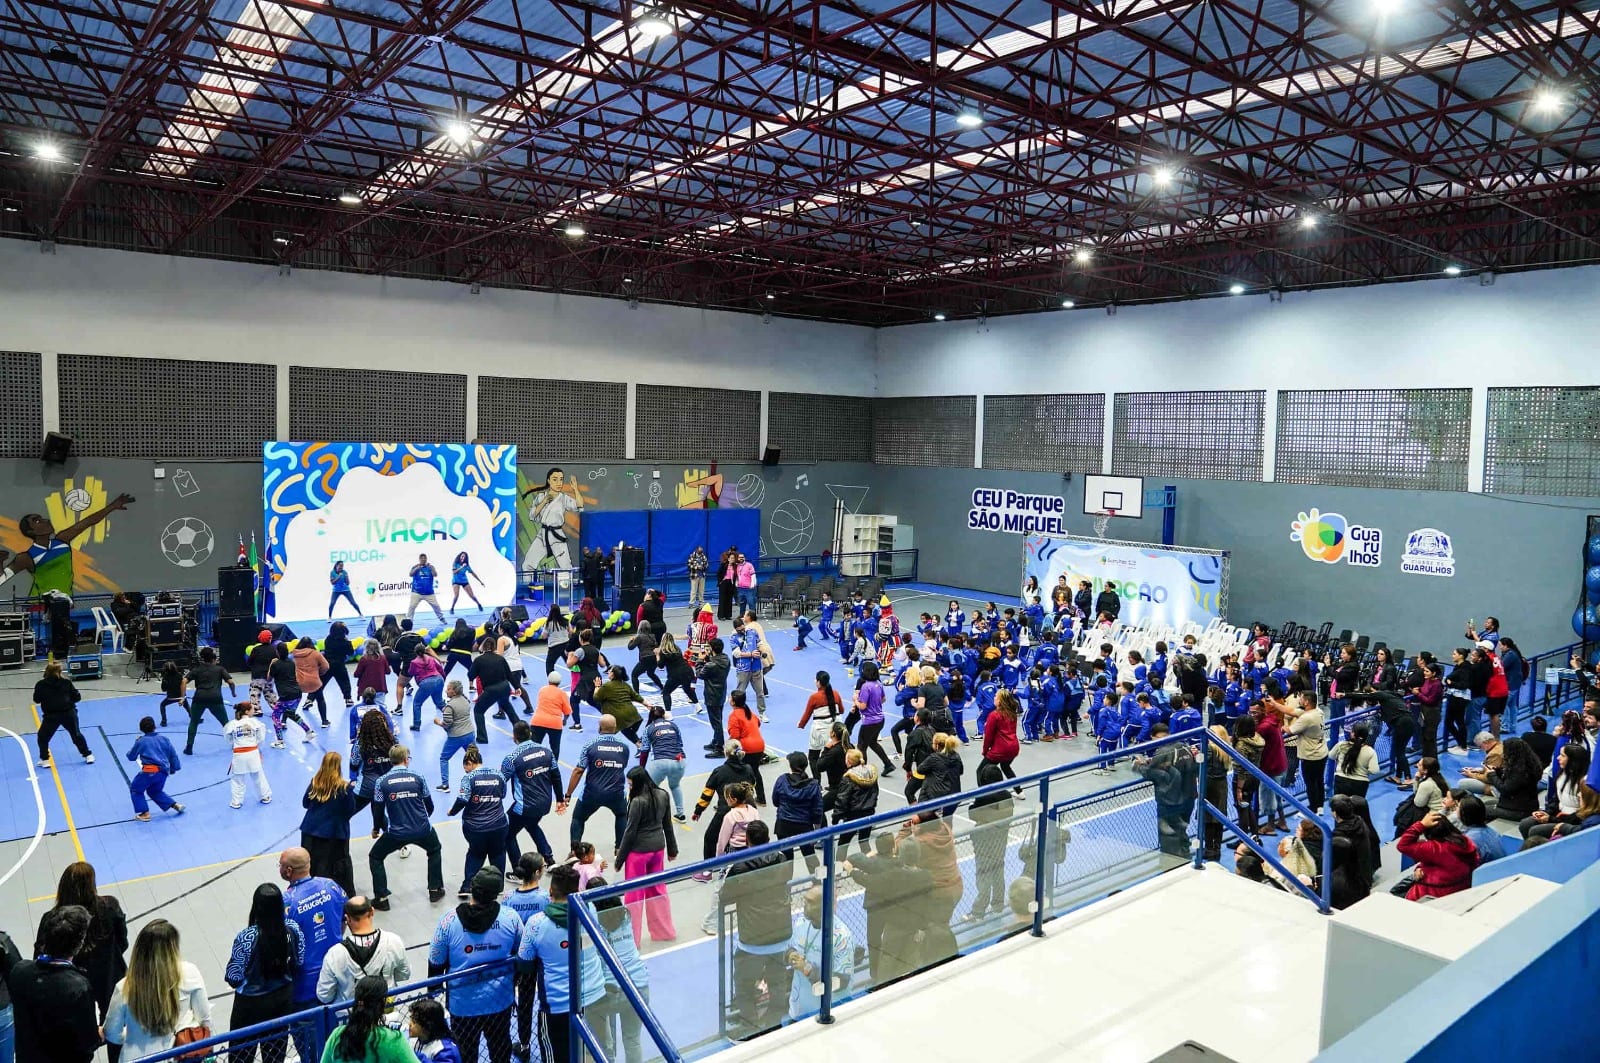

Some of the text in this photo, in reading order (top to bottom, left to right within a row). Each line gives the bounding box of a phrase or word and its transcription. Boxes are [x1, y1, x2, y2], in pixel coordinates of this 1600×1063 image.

[973, 489, 1063, 514] CEU Parque
[969, 508, 1066, 535] SÃO MIGUEL
[1351, 527, 1380, 542] Gua
[1364, 542, 1380, 553] ru
[330, 549, 387, 563] EDUCA+
[1350, 550, 1379, 565] lhos
[1403, 564, 1452, 574] GUARULHOS
[297, 894, 332, 914] Educação
[512, 903, 540, 911] EDUCADOR
